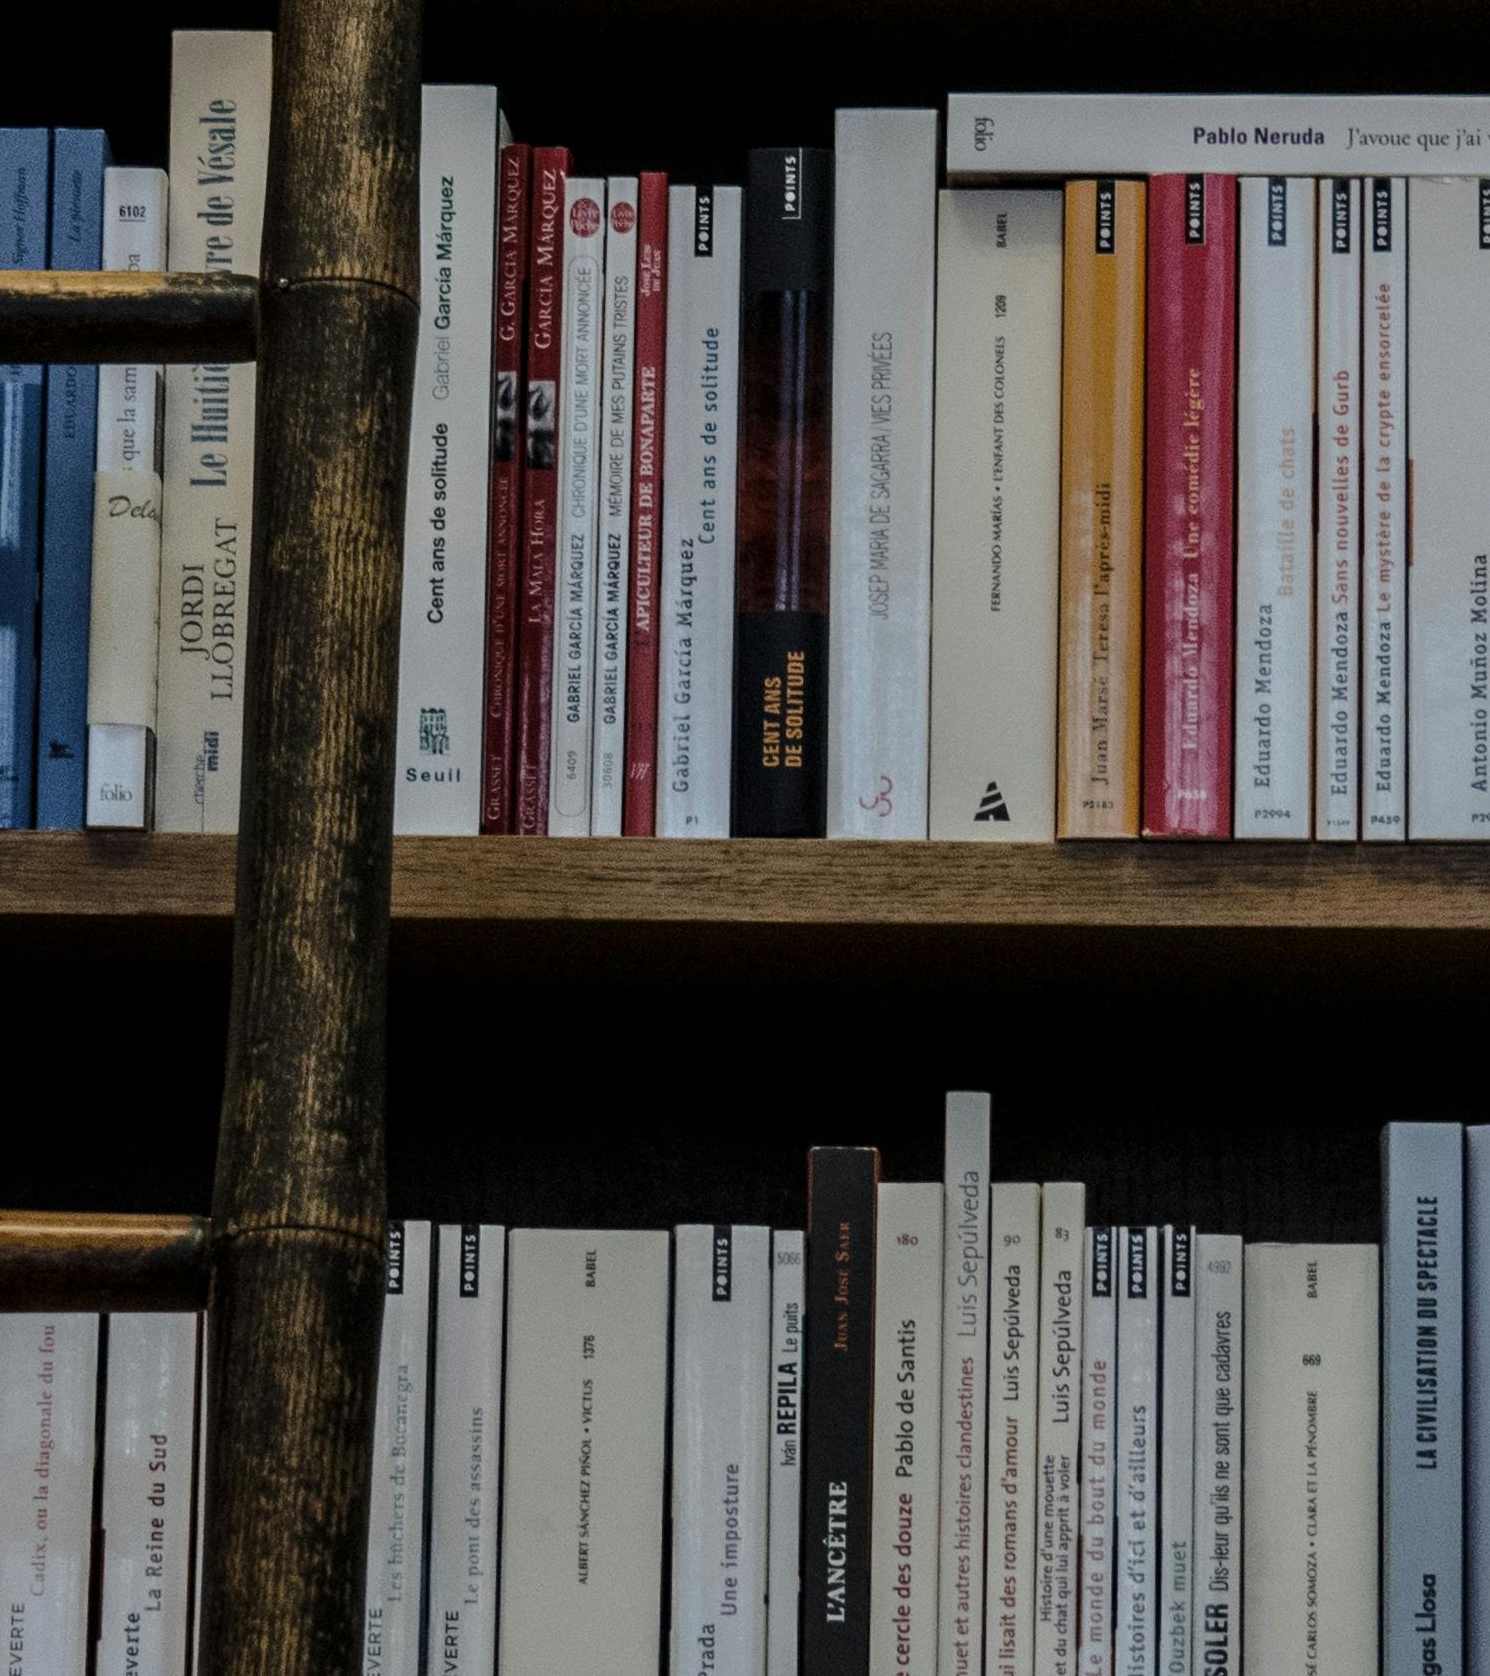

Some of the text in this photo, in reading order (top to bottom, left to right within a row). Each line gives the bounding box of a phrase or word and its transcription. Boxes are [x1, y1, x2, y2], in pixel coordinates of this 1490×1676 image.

[195, 98, 237, 227] de Vésale
[1192, 125, 1249, 146] Pablo
[1252, 125, 1326, 146] Neruda
[1345, 126, 1412, 150] J'avoue
[1415, 132, 1451, 153] que
[1455, 127, 1482, 151] j'ai
[425, 174, 457, 625] Cent ans de solitude Gabriel García Márquez
[178, 563, 211, 662] JORDI
[209, 516, 238, 701] LLOBREGAT
[1468, 552, 1489, 793] Antonio Muñoz Molina
[760, 675, 783, 768] CENT ANS
[783, 650, 806, 768] DE SOLITUDE
[776, 1362, 798, 1435] REPILA
[893, 1318, 917, 1479] Pablo de Santis
[1414, 1195, 1439, 1471] LA CIVILISATION DU SPECTACLE
[821, 1480, 849, 1623] L'ANCÊTRE
